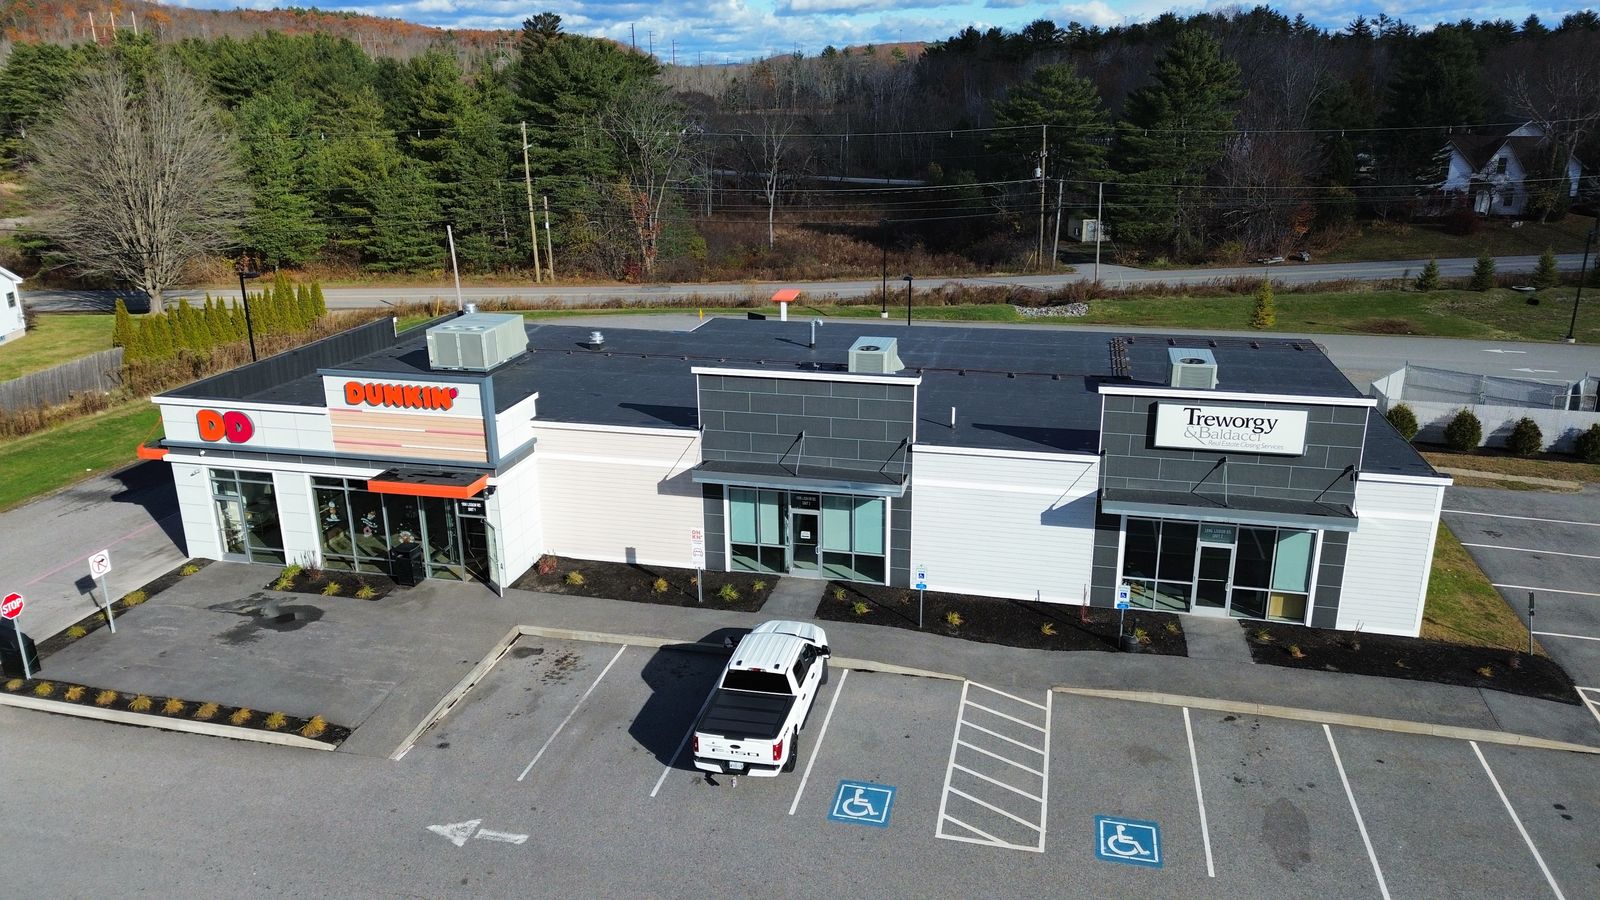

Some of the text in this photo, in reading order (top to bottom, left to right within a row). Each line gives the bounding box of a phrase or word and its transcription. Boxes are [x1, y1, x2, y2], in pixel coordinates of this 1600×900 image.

[344, 381, 459, 411] DUNKIN'
[196, 409, 255, 443] DD
[1183, 407, 1279, 434] Treworgy
[2, 597, 22, 615] STOP
